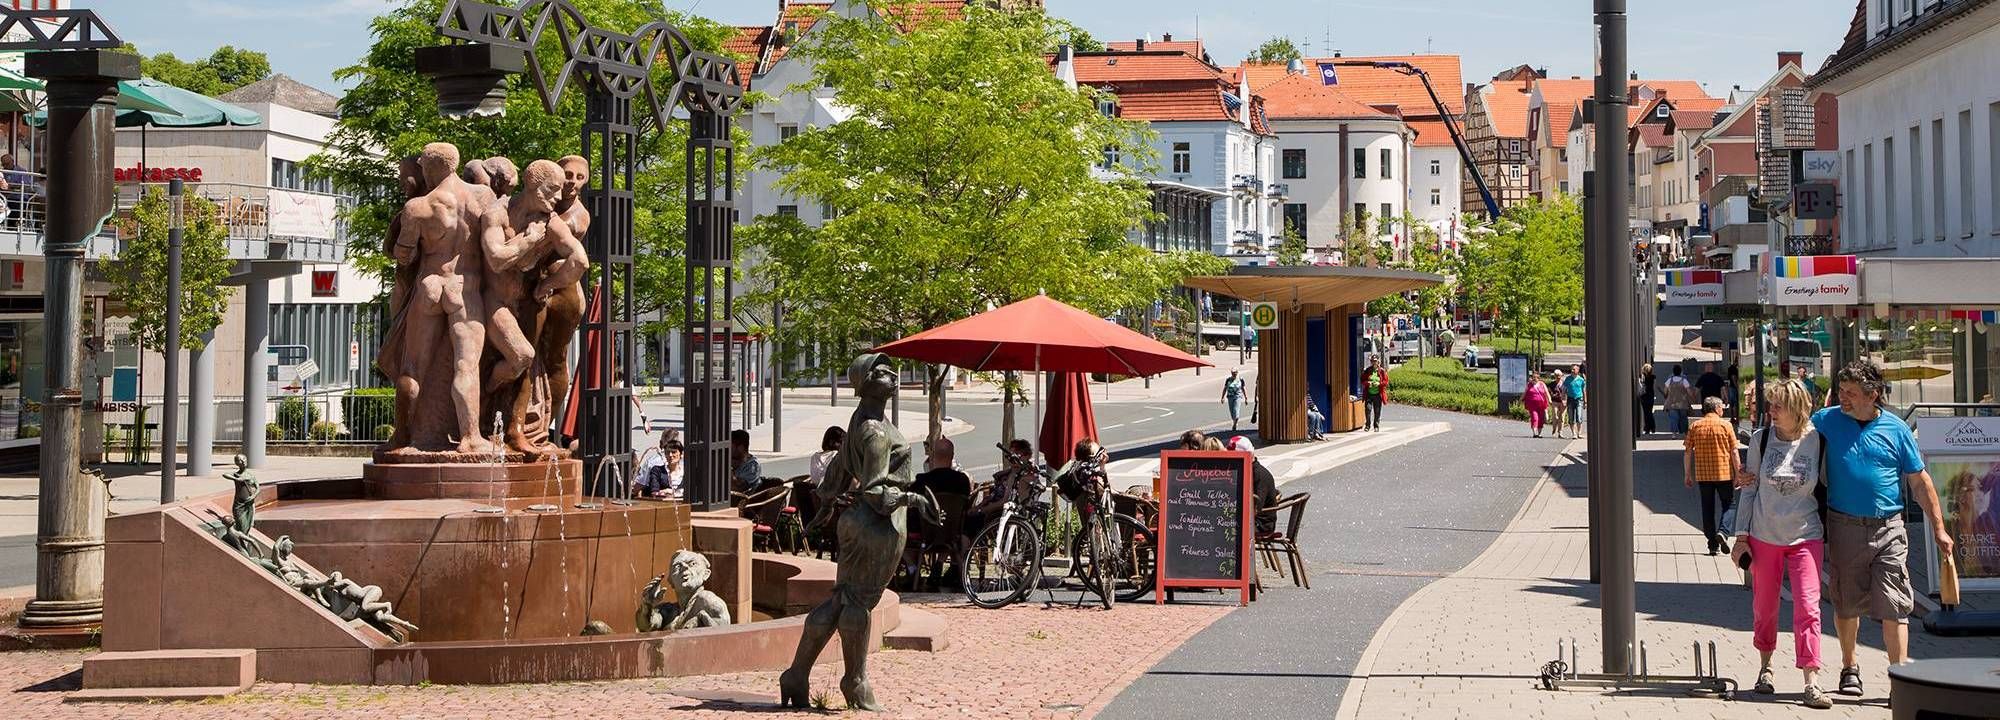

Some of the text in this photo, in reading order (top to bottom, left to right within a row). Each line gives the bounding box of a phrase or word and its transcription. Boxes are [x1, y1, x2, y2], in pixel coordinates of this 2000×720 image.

[1808, 157, 1835, 174] sky
[1801, 190, 1818, 212] T
[1696, 290, 1718, 299] family
[1820, 284, 1850, 296] family
[95, 402, 137, 413] IMBISS
[1945, 436, 1999, 444] GLASMACHER
[1183, 463, 1233, 484] Angebot
[1179, 488, 1230, 499] Grill Teller
[1188, 523, 1215, 537] Spinat
[1959, 533, 1996, 544] STARKE
[1180, 544, 1236, 558] Fitness Salat
[1960, 546, 2000, 557] OUTFITS
